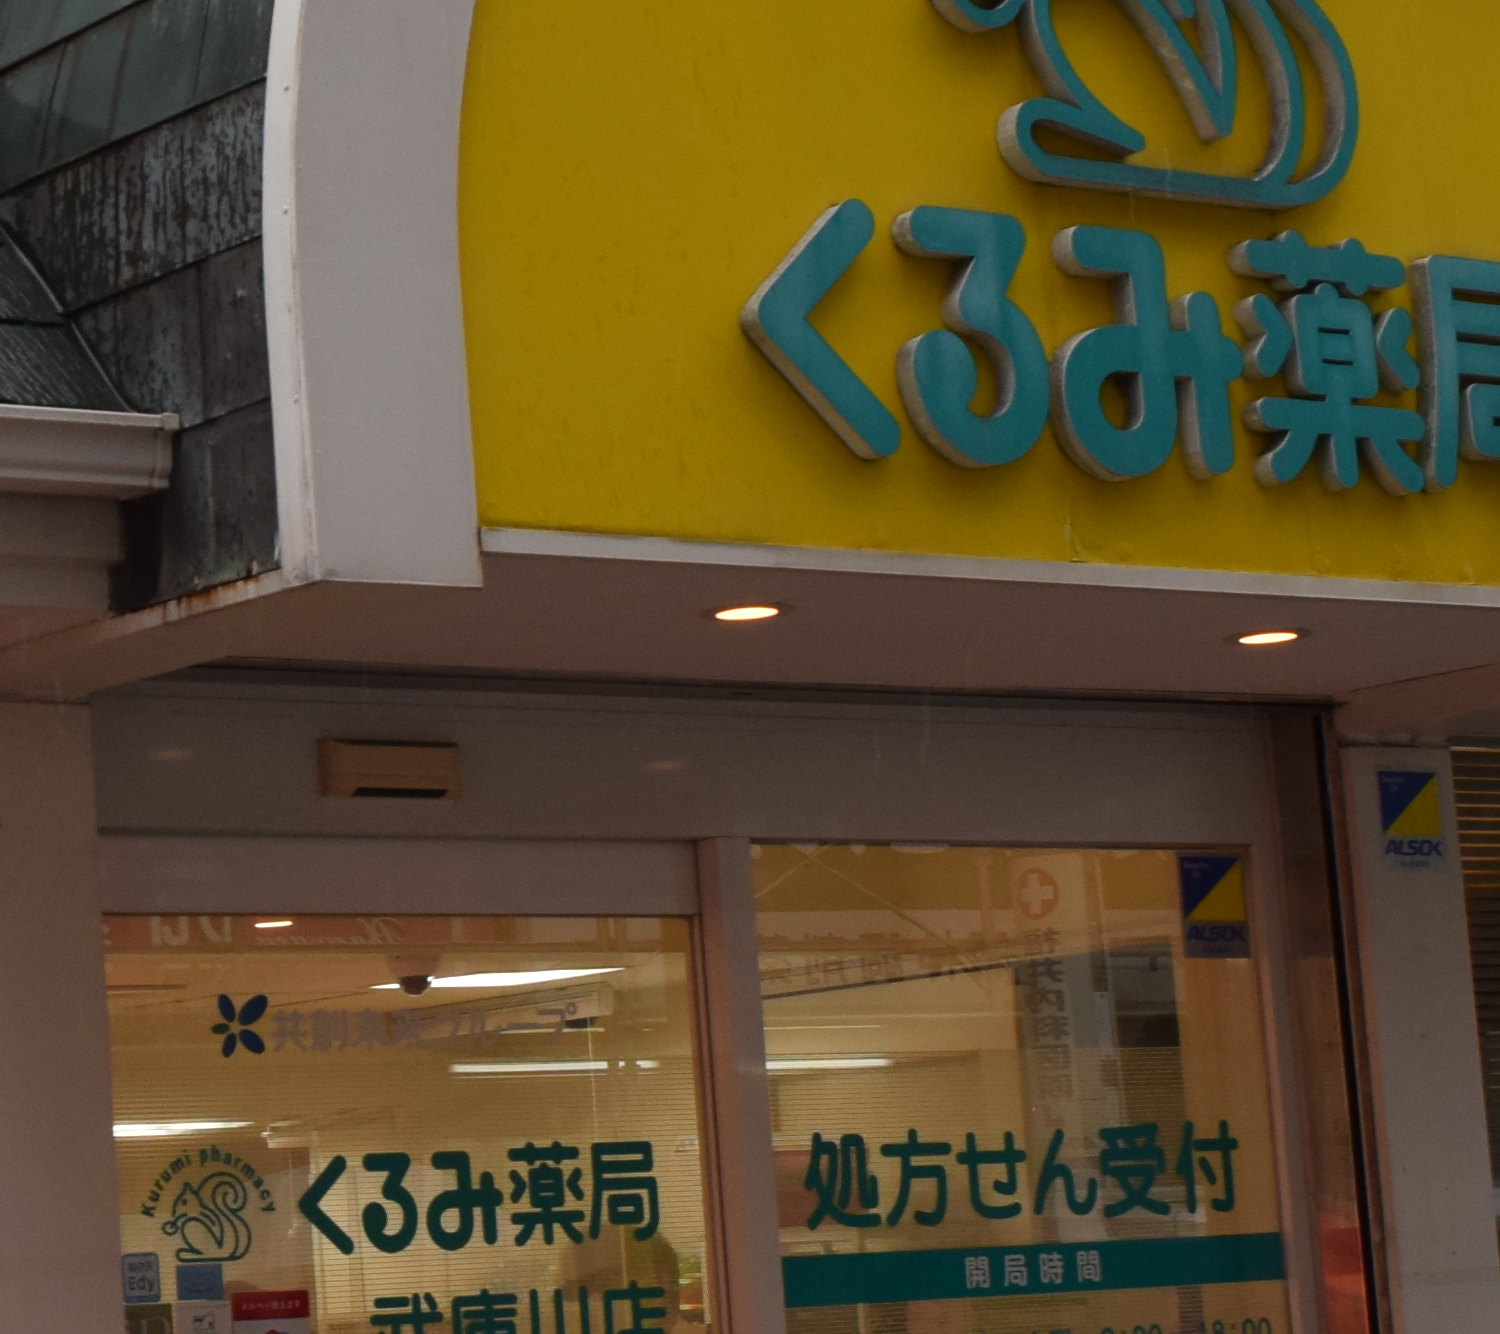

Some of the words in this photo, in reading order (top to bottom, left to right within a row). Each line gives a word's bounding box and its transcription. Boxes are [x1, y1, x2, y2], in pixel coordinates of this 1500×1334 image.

[1385, 840, 1443, 856] ALSOK
[1187, 925, 1247, 942] ALSOK
[141, 1148, 191, 1217] Kurumi
[199, 1144, 276, 1212] pharmacy
[804, 1120, 1239, 1231] 処方せん受付
[298, 1140, 661, 1255] くるみ薬局
[128, 1275, 155, 1293] Edy
[964, 1250, 1104, 1290] 開局時間
